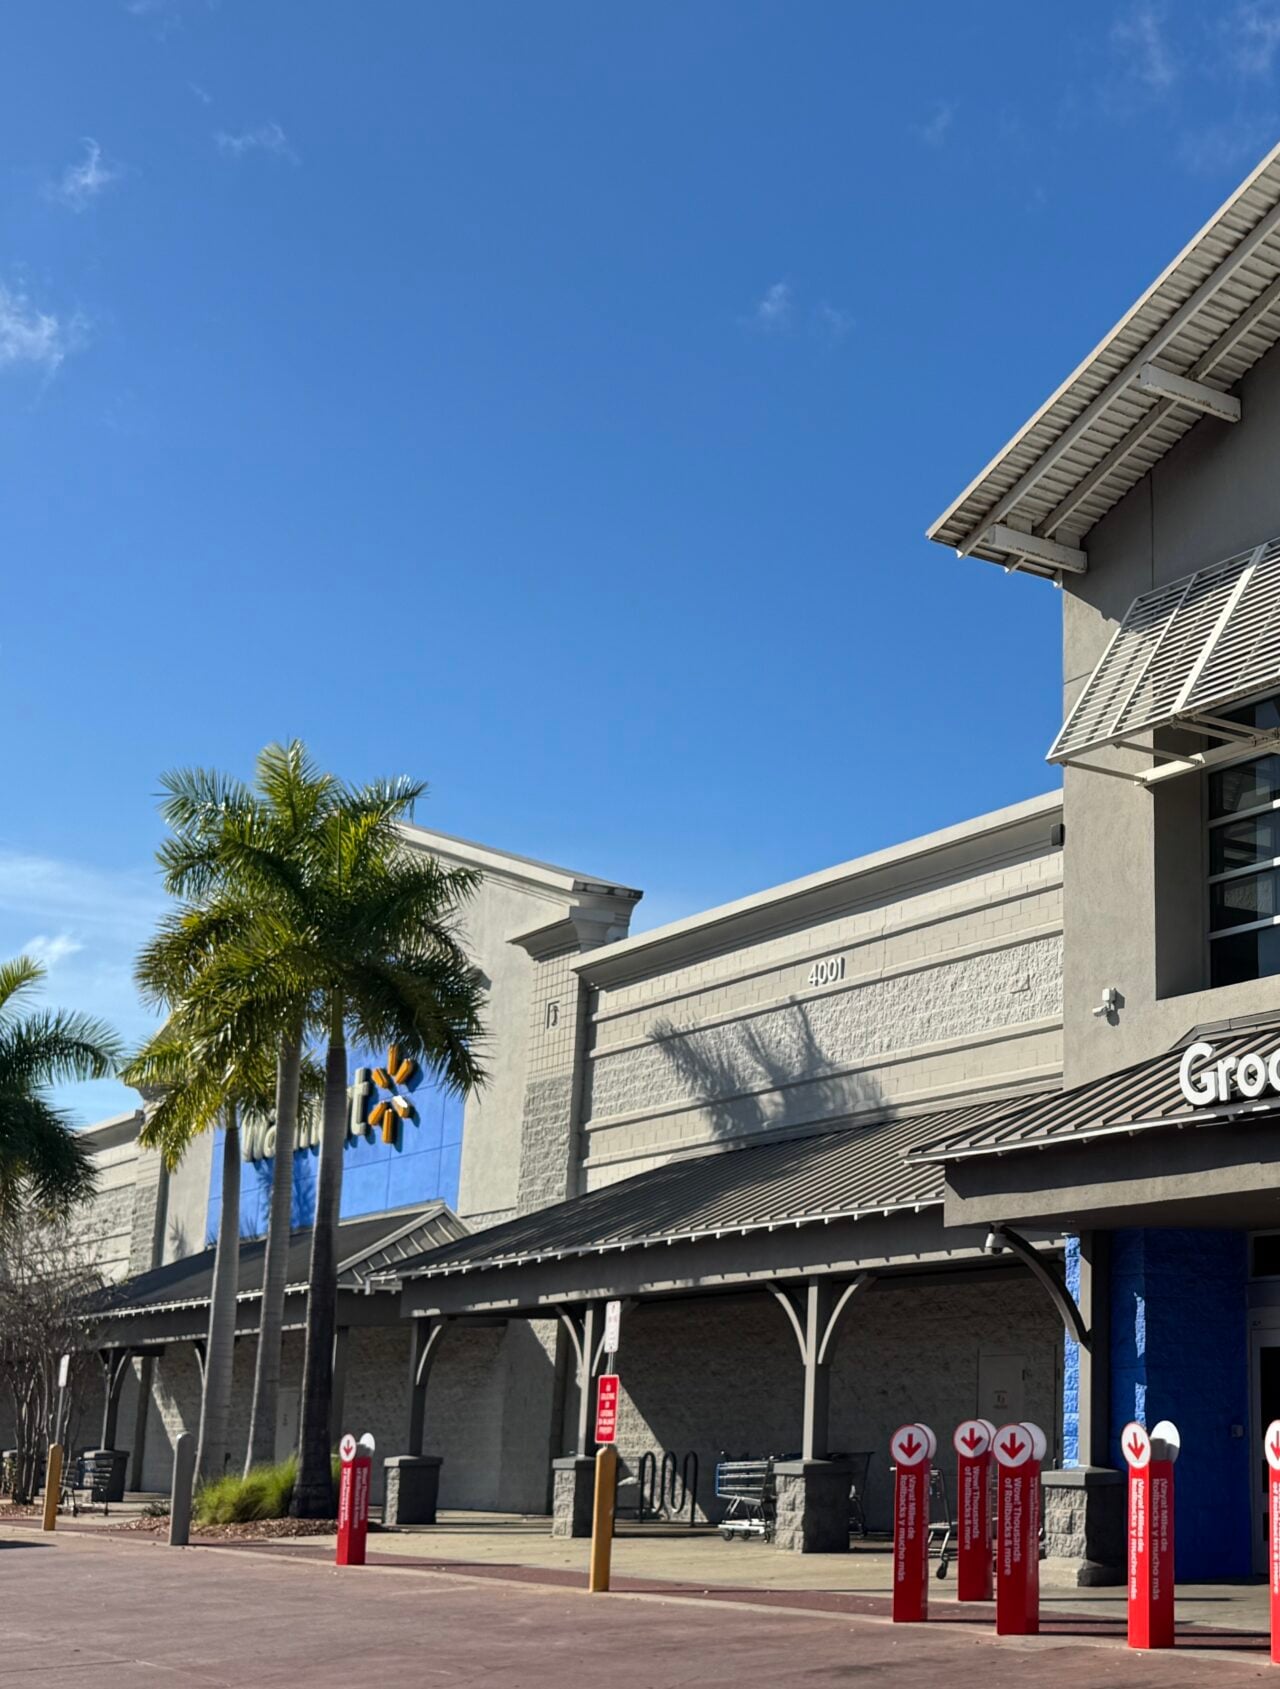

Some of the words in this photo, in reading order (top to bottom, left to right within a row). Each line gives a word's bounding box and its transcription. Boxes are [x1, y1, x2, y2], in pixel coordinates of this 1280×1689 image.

[808, 957, 845, 987] 4001
[1005, 1478, 1012, 1488] of
[1014, 1477, 1022, 1504] Wow!
[1005, 1490, 1013, 1537] Rollbacks
[908, 1527, 916, 1539] de
[1013, 1506, 1022, 1562] Thousands
[1160, 1538, 1168, 1552] de
[1152, 1539, 1160, 1576] mucho
